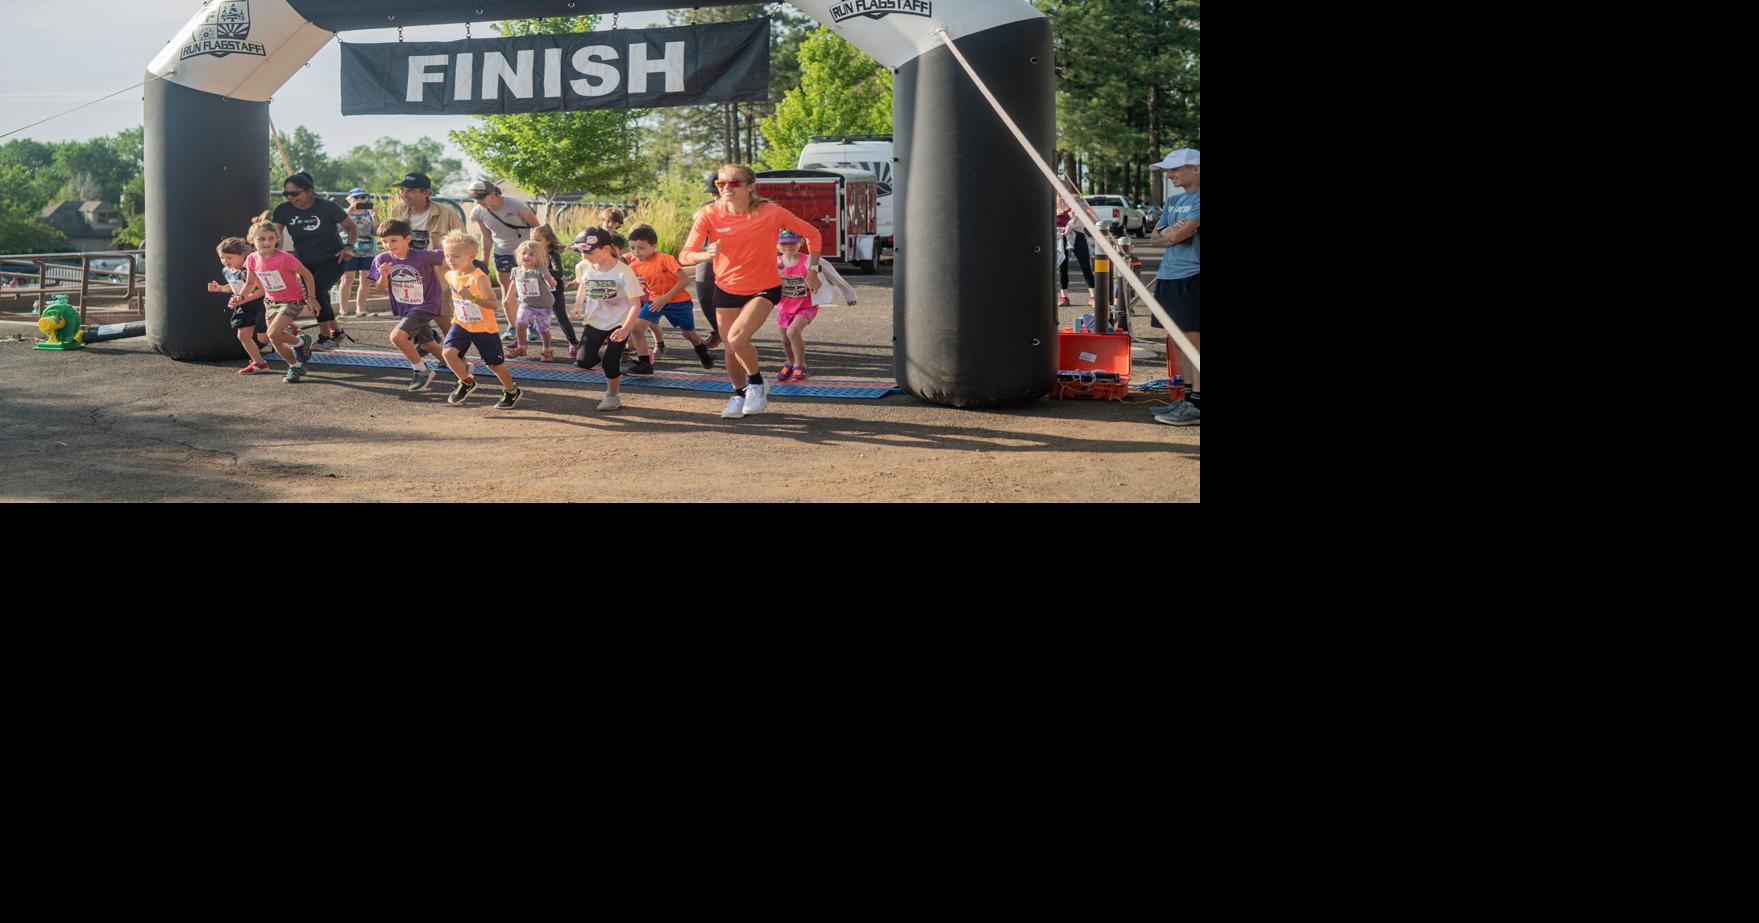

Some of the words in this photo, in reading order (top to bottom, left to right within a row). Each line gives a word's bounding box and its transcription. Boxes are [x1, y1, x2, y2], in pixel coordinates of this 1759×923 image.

[832, 0, 854, 19] RUN
[856, 0, 929, 12] FLAGSTAFF
[183, 42, 201, 56] RUN
[203, 40, 262, 53] FLAGSTAFF
[405, 40, 685, 102] FINISH
[264, 277, 272, 287] 1
[523, 283, 529, 292] 1
[403, 288, 409, 299] 1
[461, 306, 468, 317] 1
